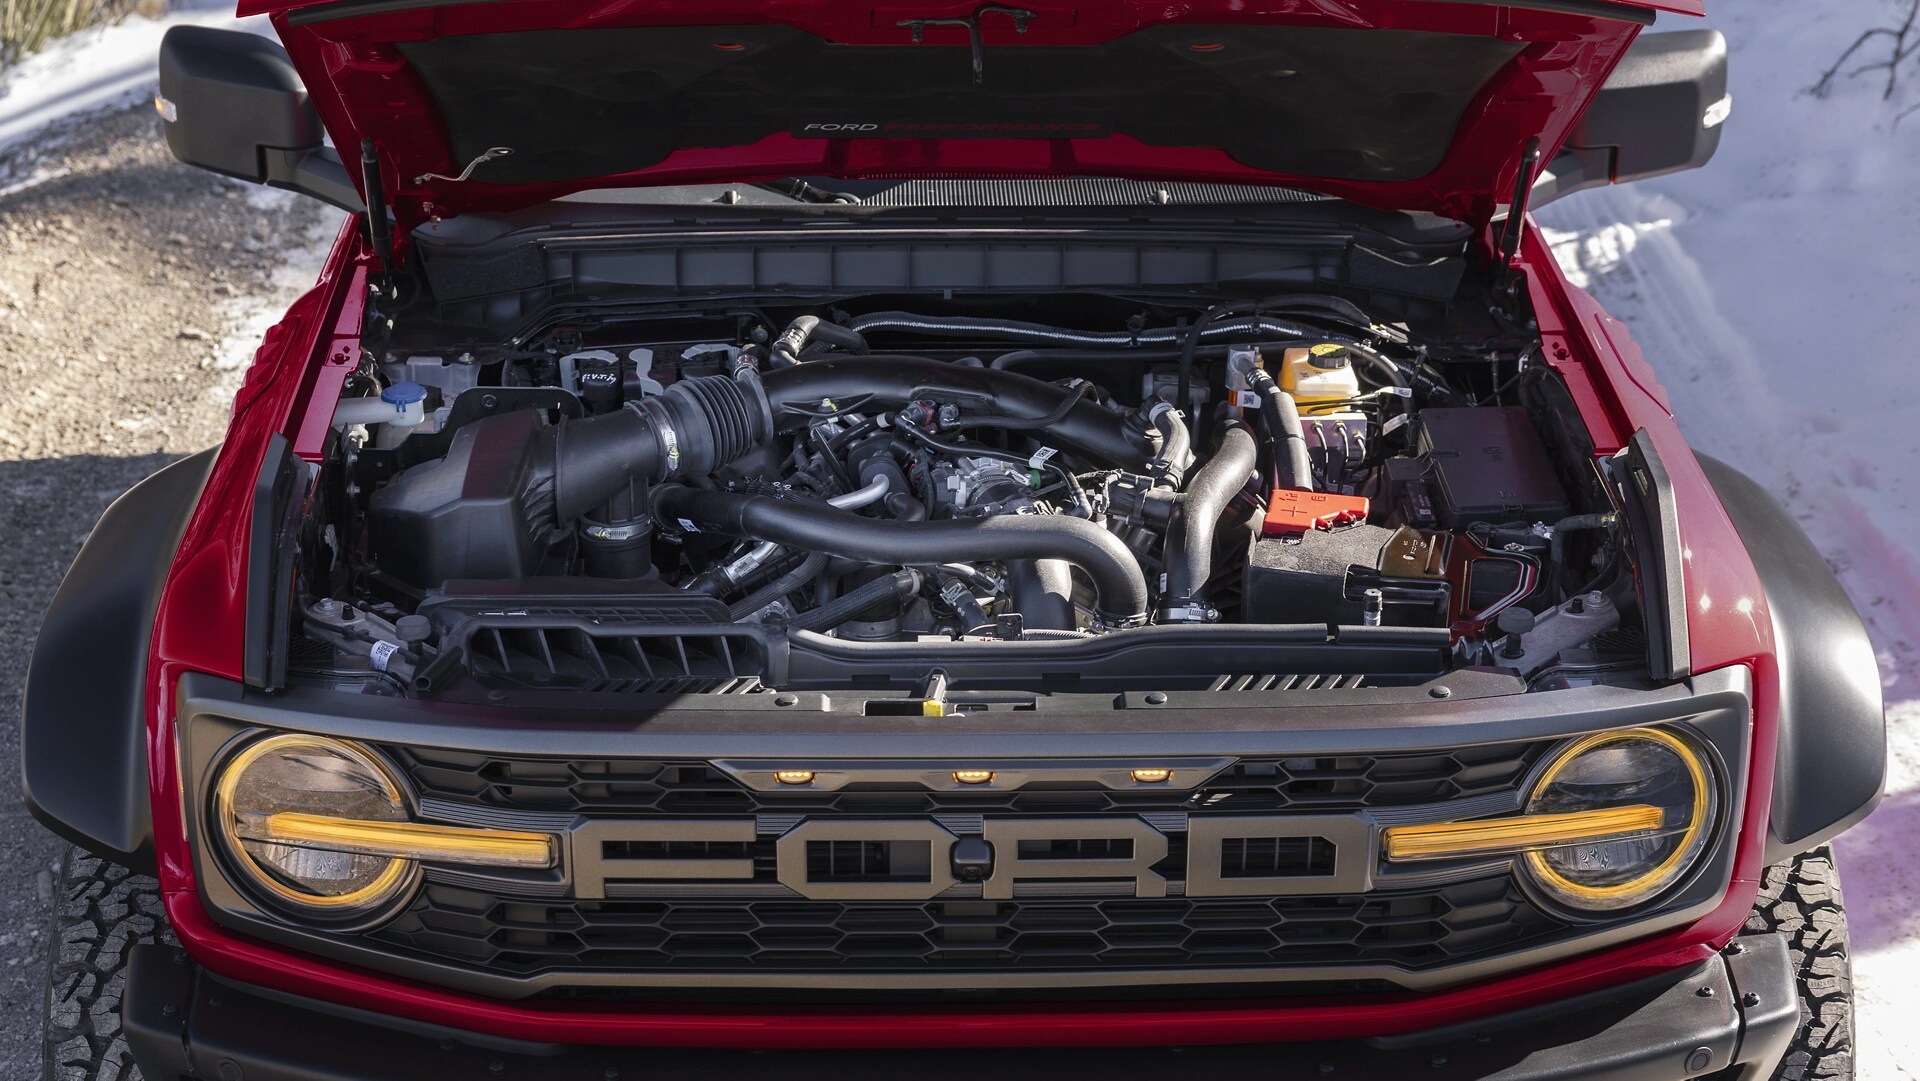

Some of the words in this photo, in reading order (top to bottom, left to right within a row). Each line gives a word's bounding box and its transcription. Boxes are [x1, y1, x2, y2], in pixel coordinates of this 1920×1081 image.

[804, 123, 878, 131] FORD
[883, 123, 1101, 131] PERFORMANCE
[572, 814, 1370, 899] FORD
